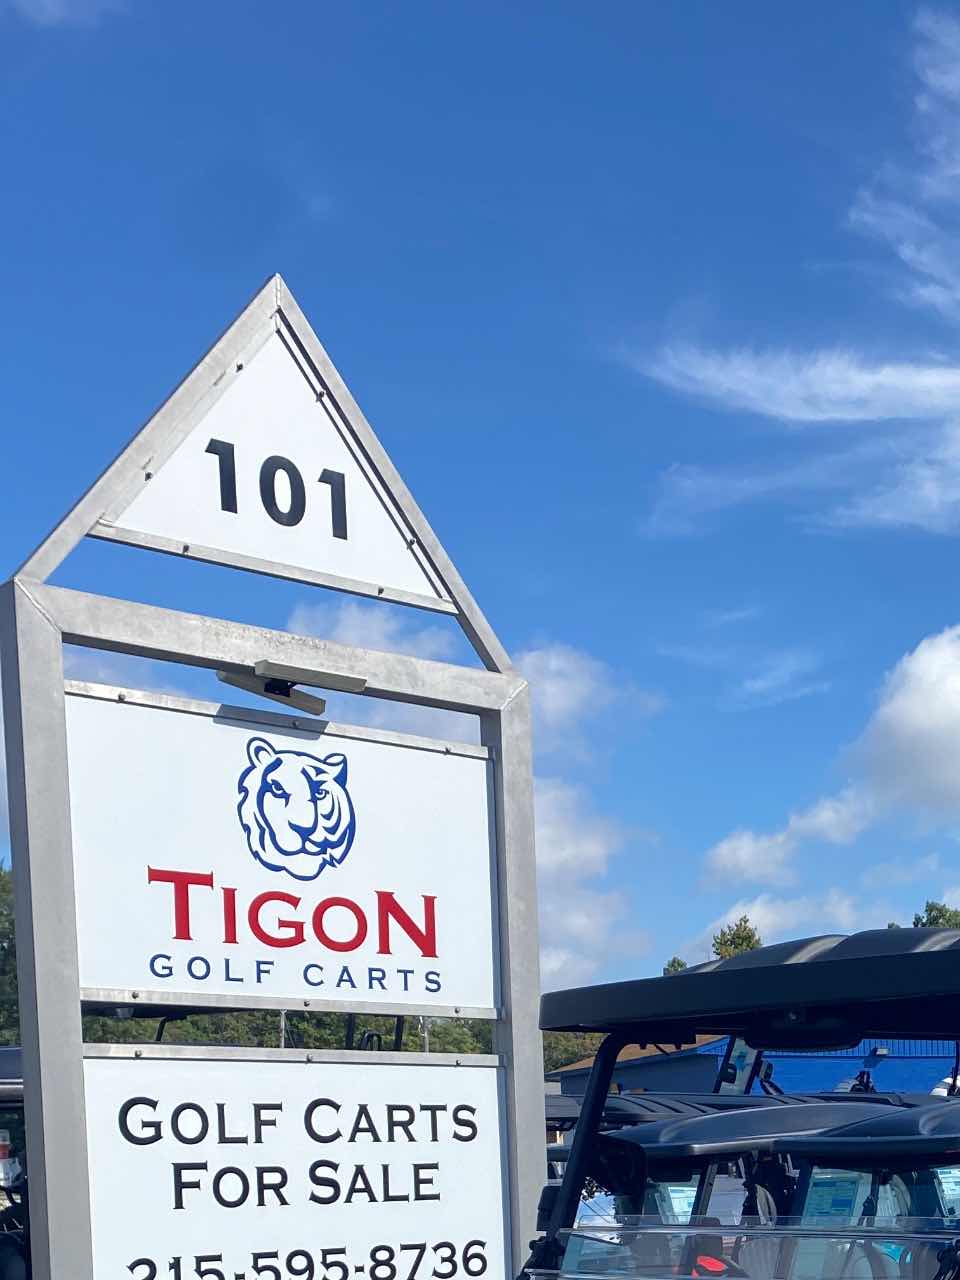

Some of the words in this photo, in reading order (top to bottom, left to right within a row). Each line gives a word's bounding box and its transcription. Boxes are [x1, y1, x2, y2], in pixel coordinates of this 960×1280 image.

[204, 438, 348, 541] 101
[147, 864, 439, 959] TIGON
[149, 953, 275, 984] GOLF
[302, 963, 442, 993] CARTS
[117, 1096, 283, 1146] GOLF
[303, 1097, 479, 1143] CARTS
[170, 1160, 291, 1210] FOR
[308, 1159, 441, 1205] SALE
